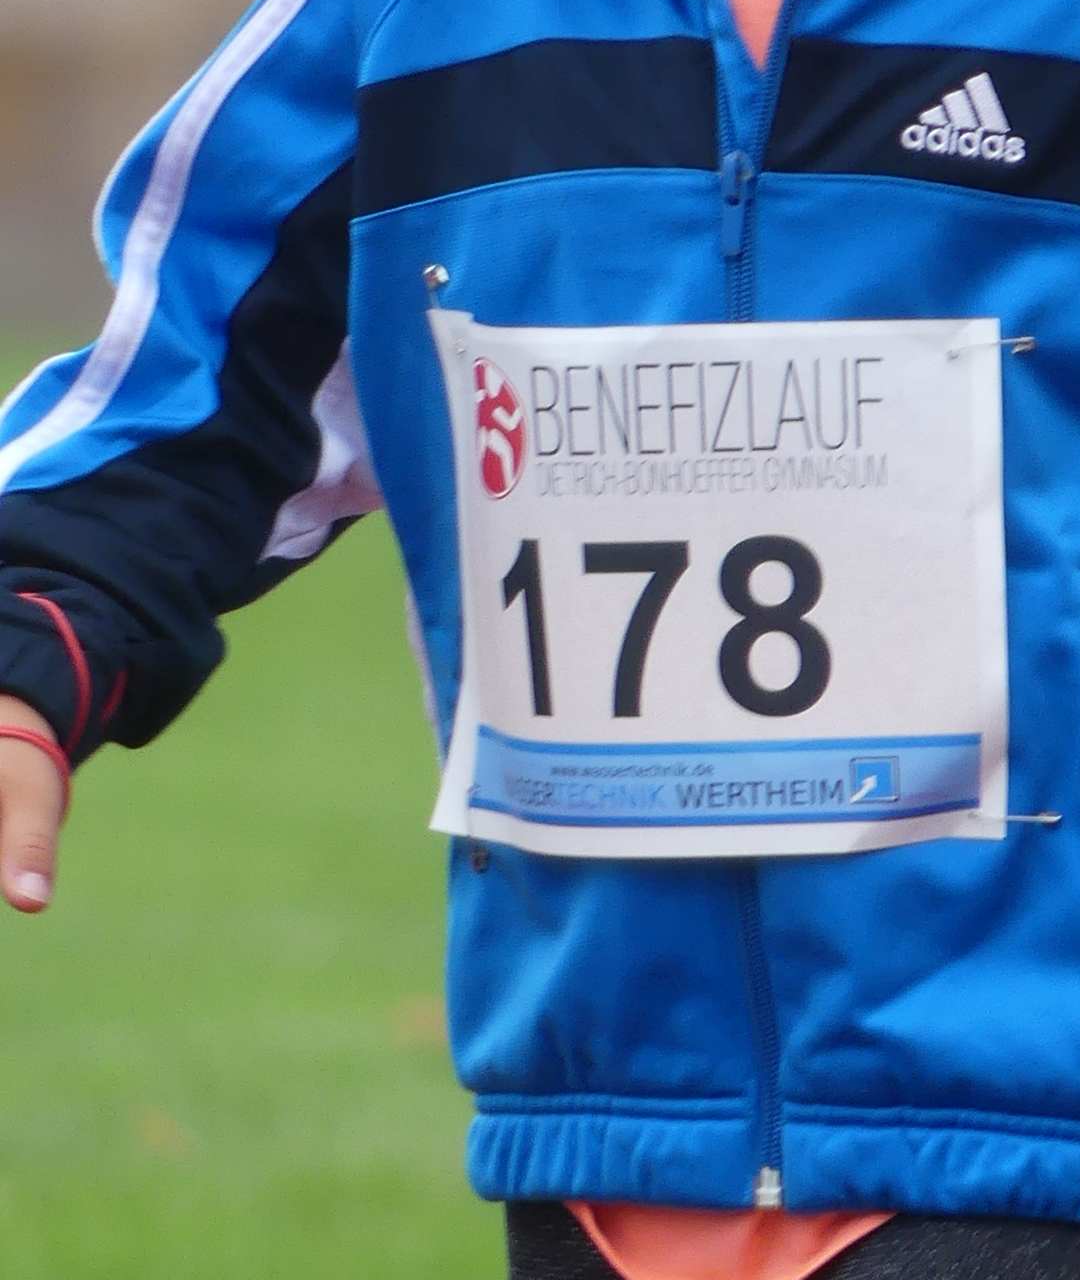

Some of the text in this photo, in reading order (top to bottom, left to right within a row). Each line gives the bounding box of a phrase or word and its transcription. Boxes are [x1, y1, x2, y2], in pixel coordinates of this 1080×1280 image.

[900, 123, 1027, 164] adidas
[531, 357, 884, 457] BENEFIZLAUF
[763, 453, 889, 494] GYMNASIUM
[502, 534, 833, 718] 178
[674, 778, 845, 810] WERTHEIM
